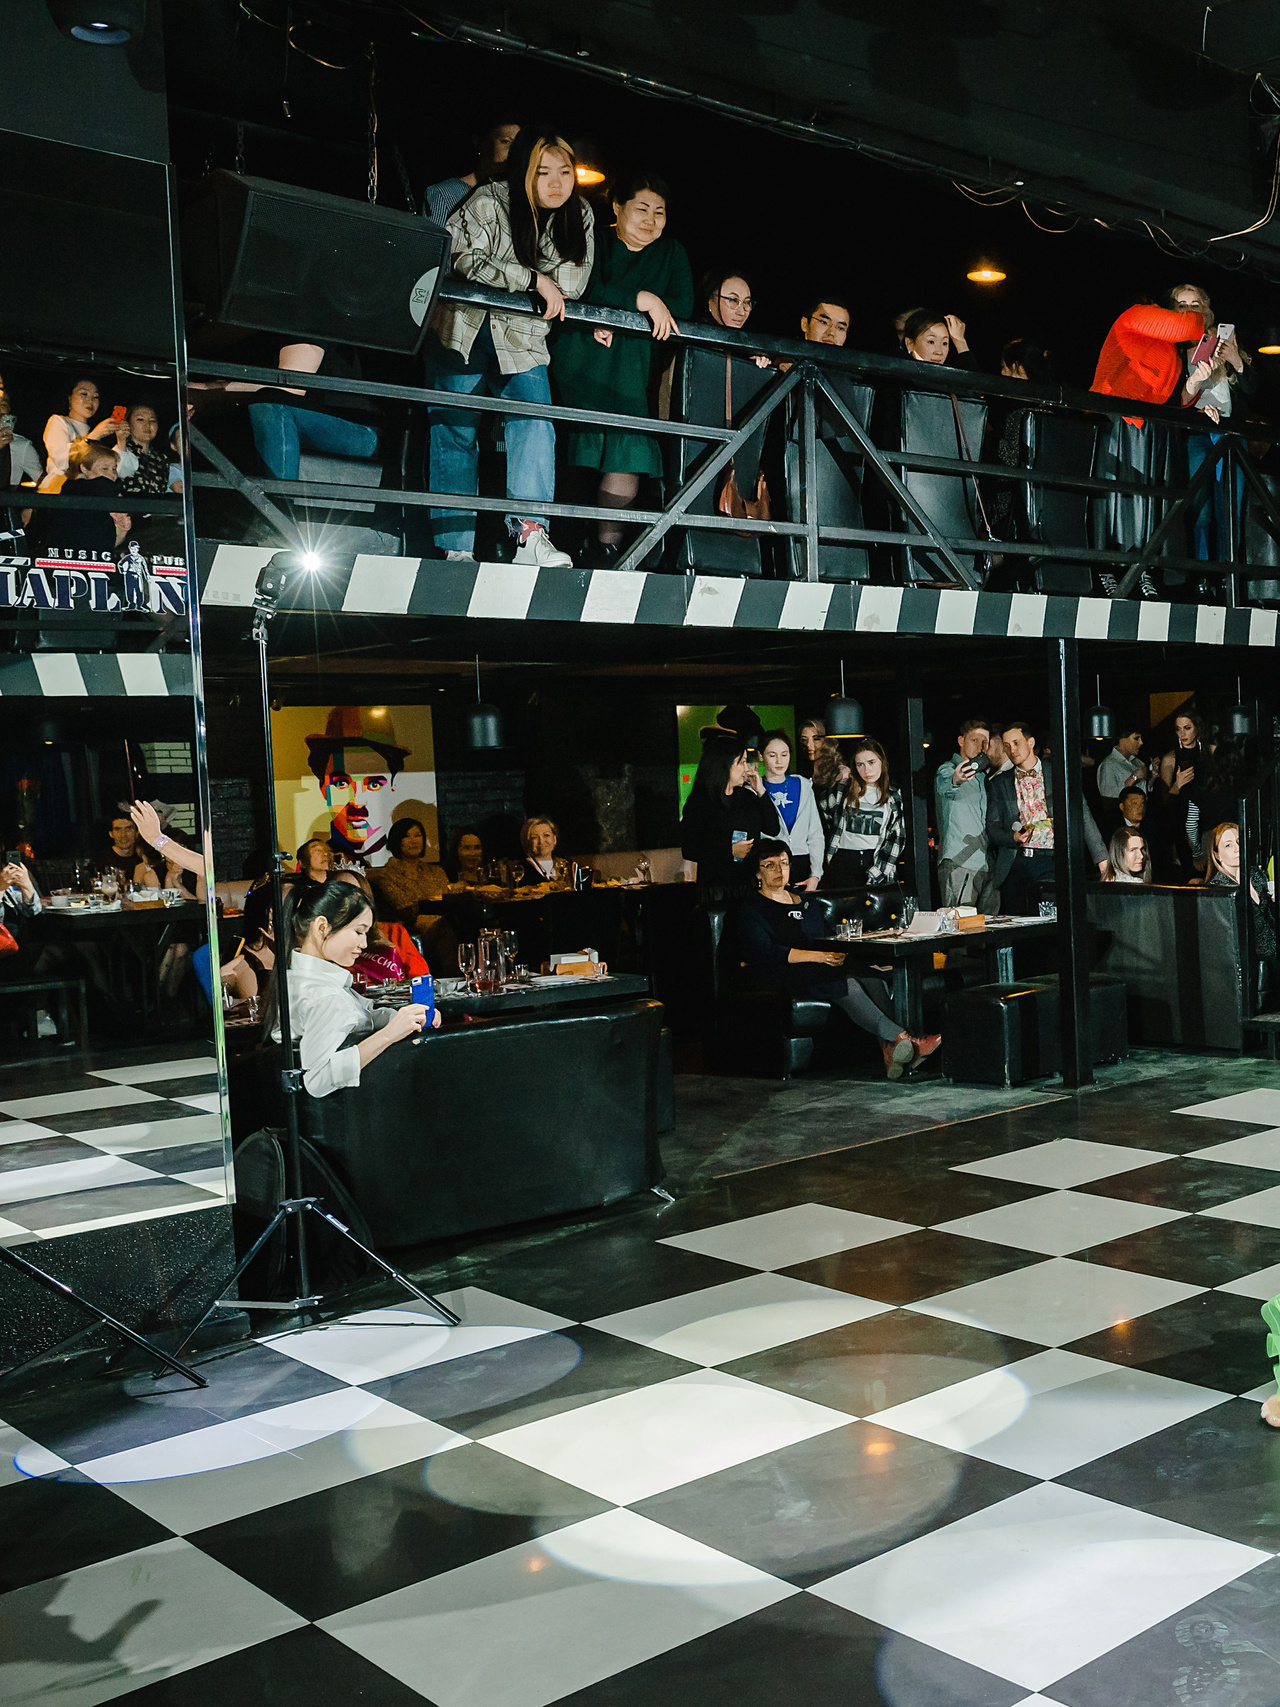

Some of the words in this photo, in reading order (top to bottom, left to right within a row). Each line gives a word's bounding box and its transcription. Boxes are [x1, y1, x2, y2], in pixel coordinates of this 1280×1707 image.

[47, 547, 112, 561] MUSIC
[152, 555, 186, 566] PUB
[361, 952, 399, 973] ИССИС
